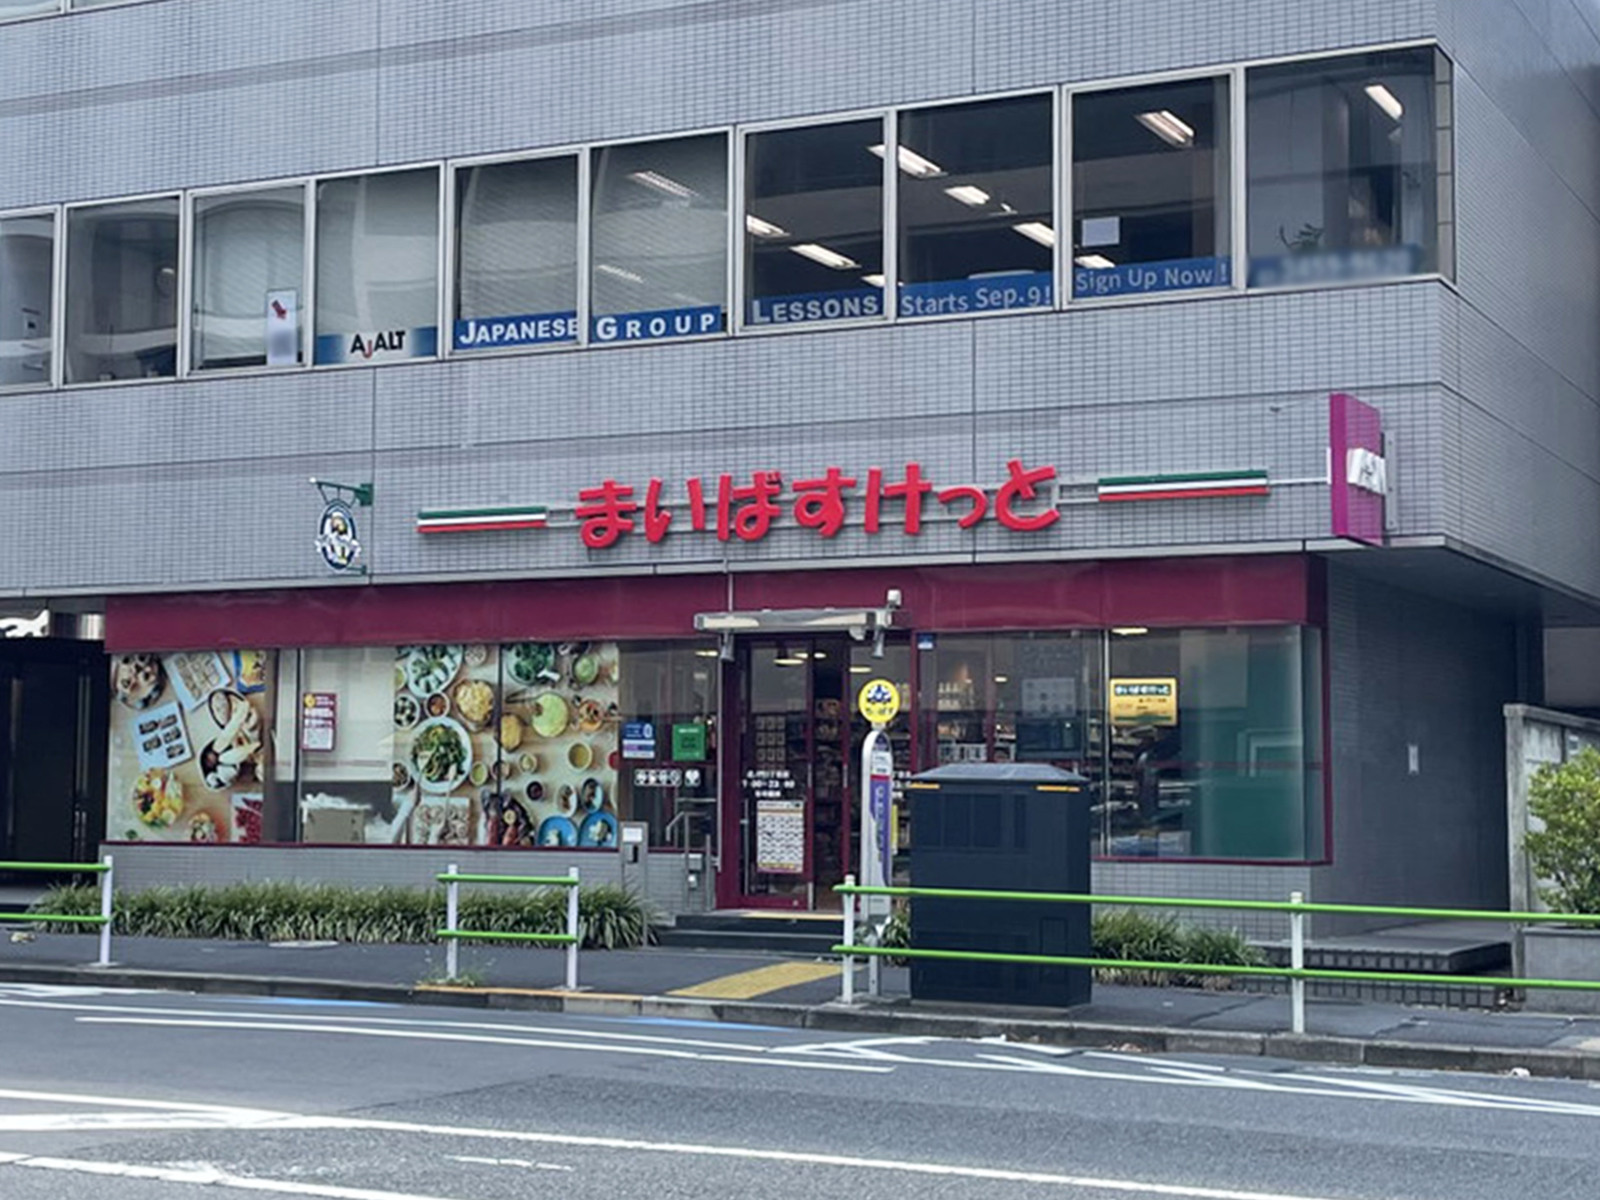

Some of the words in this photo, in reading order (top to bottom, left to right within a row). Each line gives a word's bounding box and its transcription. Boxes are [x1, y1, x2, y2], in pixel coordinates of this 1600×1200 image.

[1076, 271, 1121, 294] Sign
[1128, 268, 1157, 290] Up
[752, 295, 879, 324] LESSONS
[901, 295, 969, 316] Starts
[459, 318, 579, 344] JAPANESE
[596, 314, 716, 340] GROUP
[575, 458, 1061, 548] まいばすけっと
